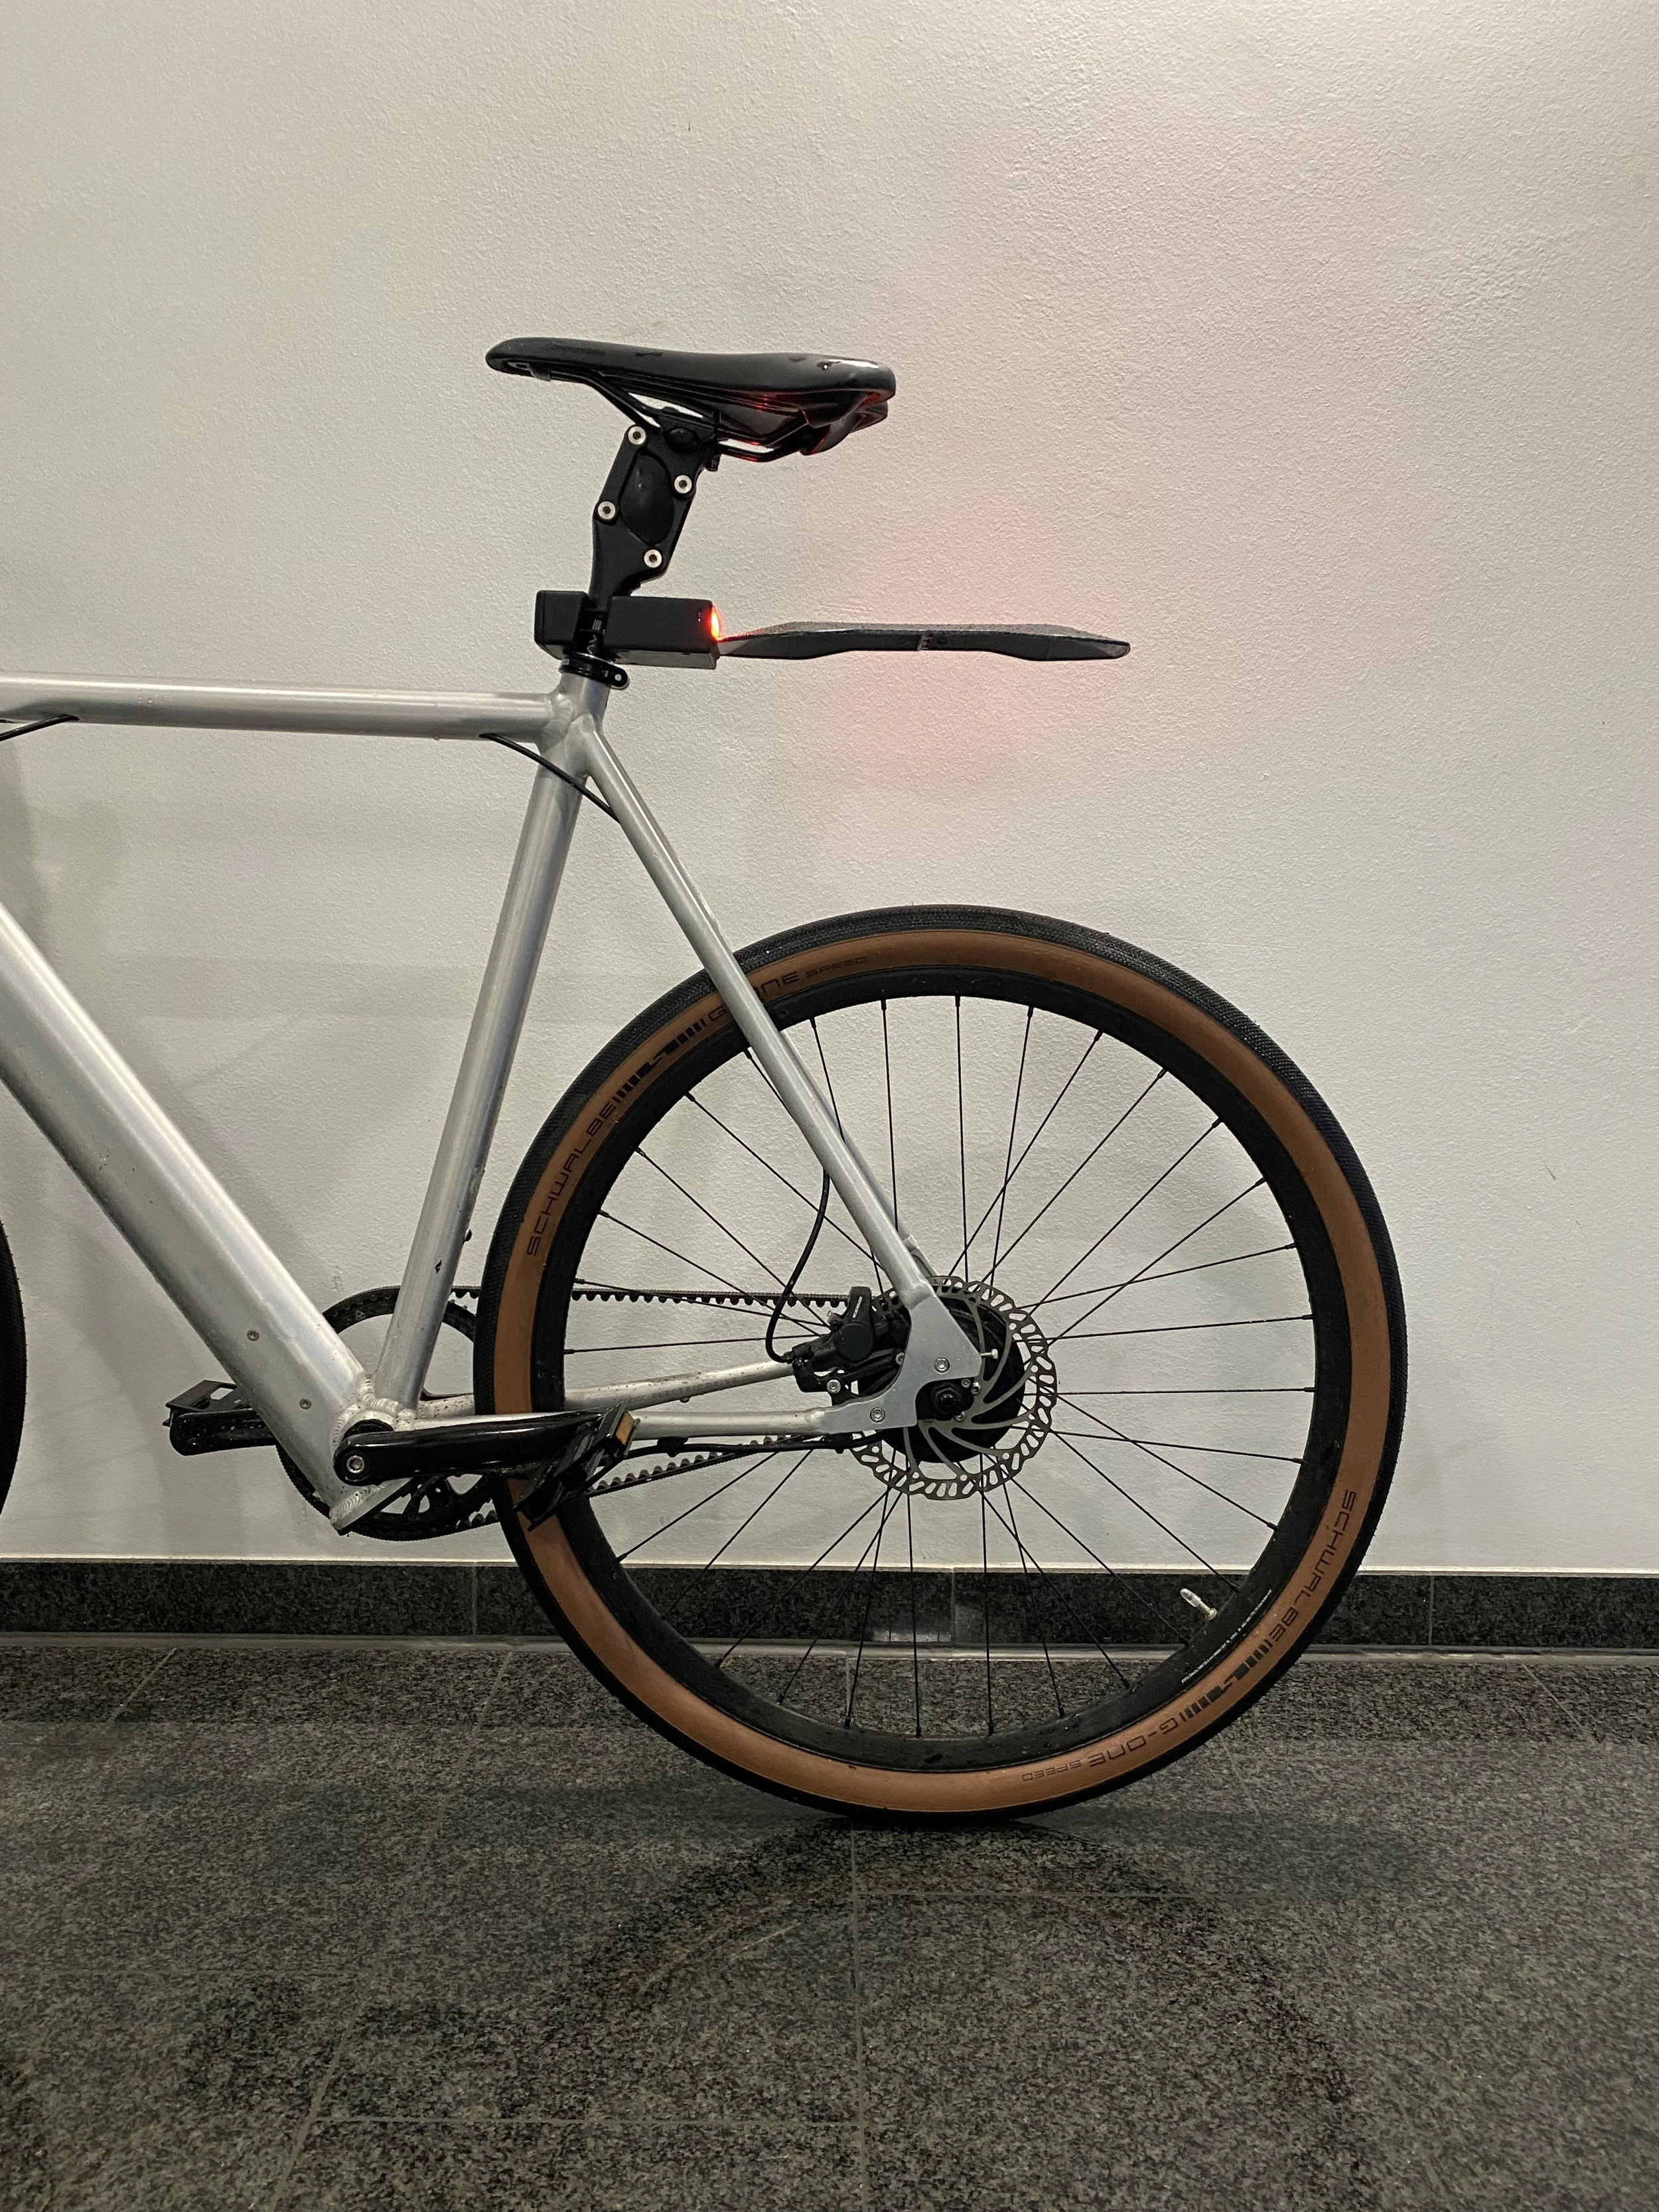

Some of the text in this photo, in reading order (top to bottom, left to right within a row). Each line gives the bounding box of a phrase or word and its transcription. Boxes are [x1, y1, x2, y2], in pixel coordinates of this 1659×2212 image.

[526, 1101, 616, 1256] SCHWALBE
[806, 956, 867, 978] SPEED
[1268, 1489, 1356, 1642] SCHWALBE
[1021, 1759, 1082, 1781] SPEED
[1087, 1718, 1179, 1767] G-ONE
